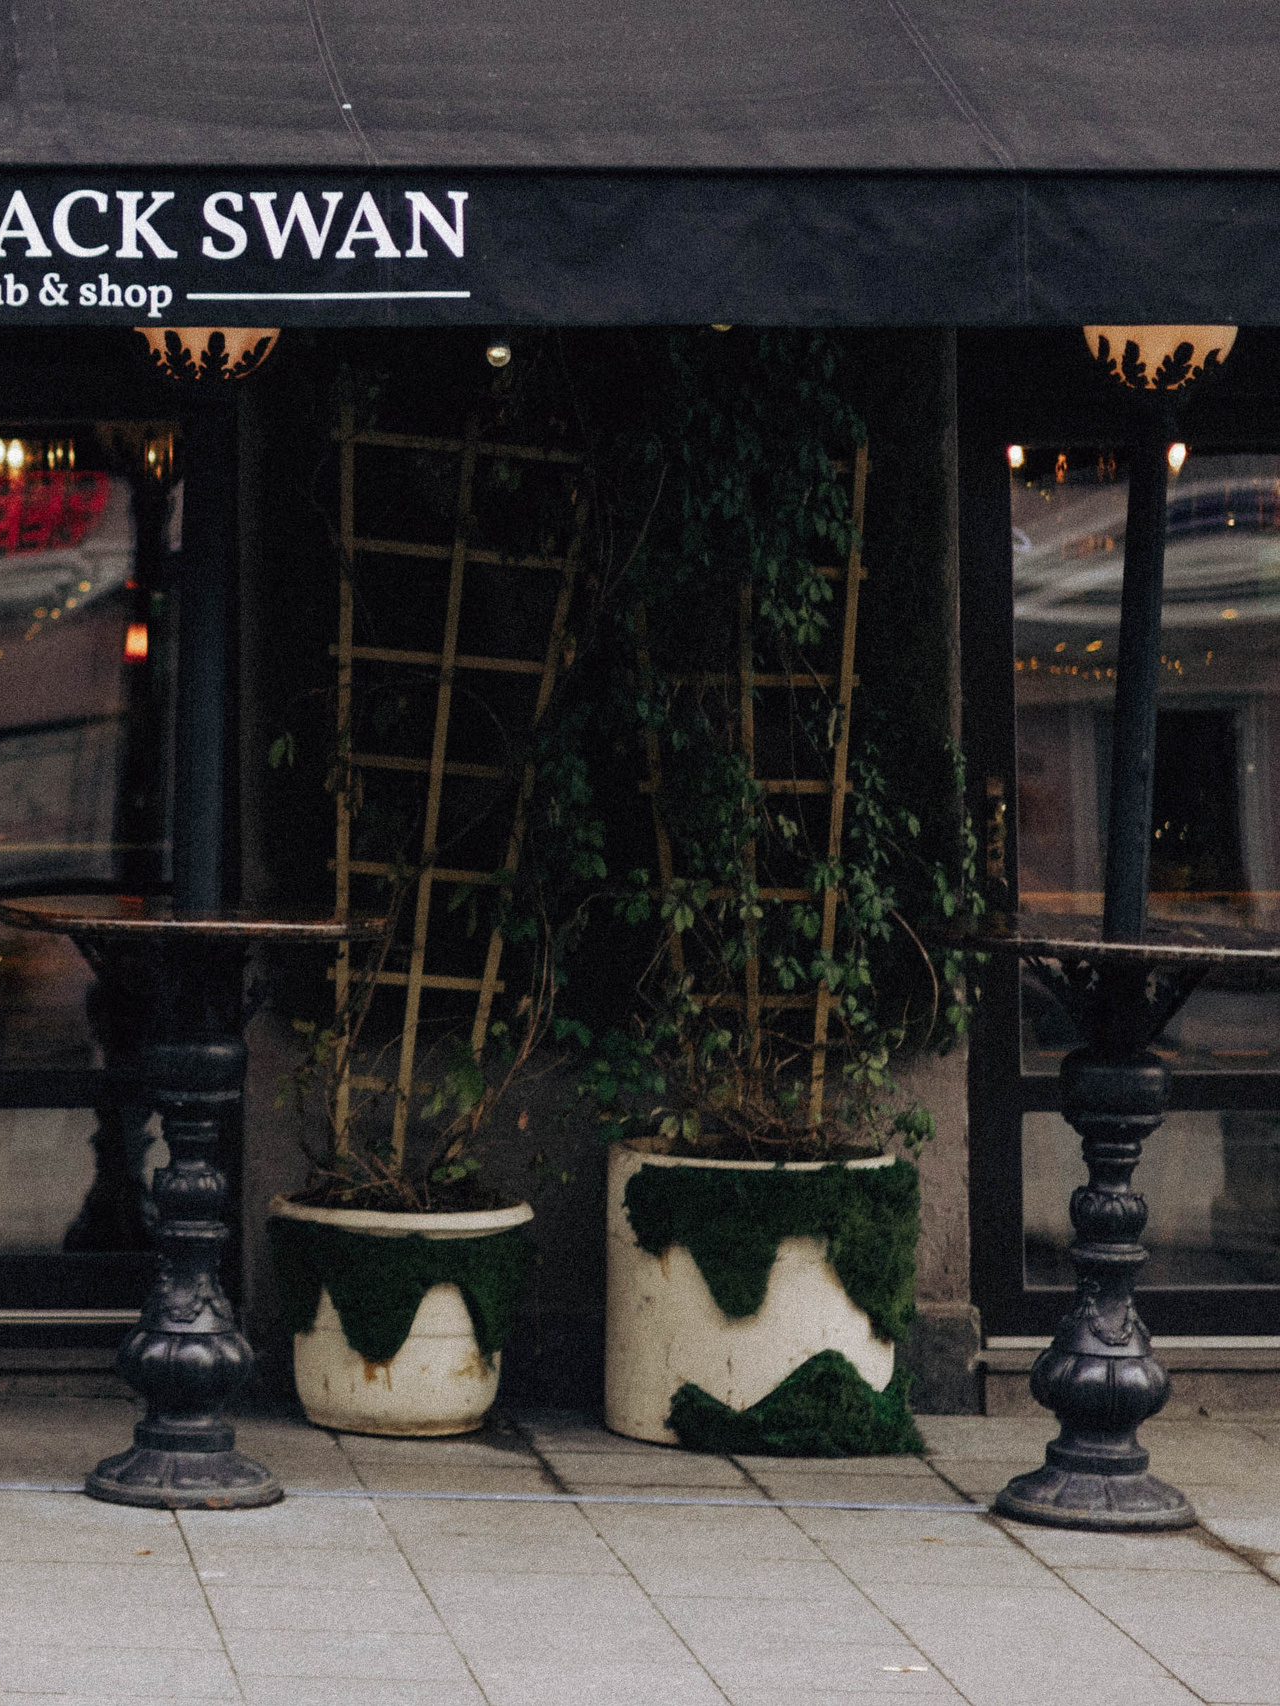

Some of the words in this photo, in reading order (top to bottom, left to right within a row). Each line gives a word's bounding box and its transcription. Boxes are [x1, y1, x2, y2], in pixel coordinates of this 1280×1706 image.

[201, 190, 470, 260] SWAN
[38, 272, 70, 307] &
[79, 272, 173, 319] shop
